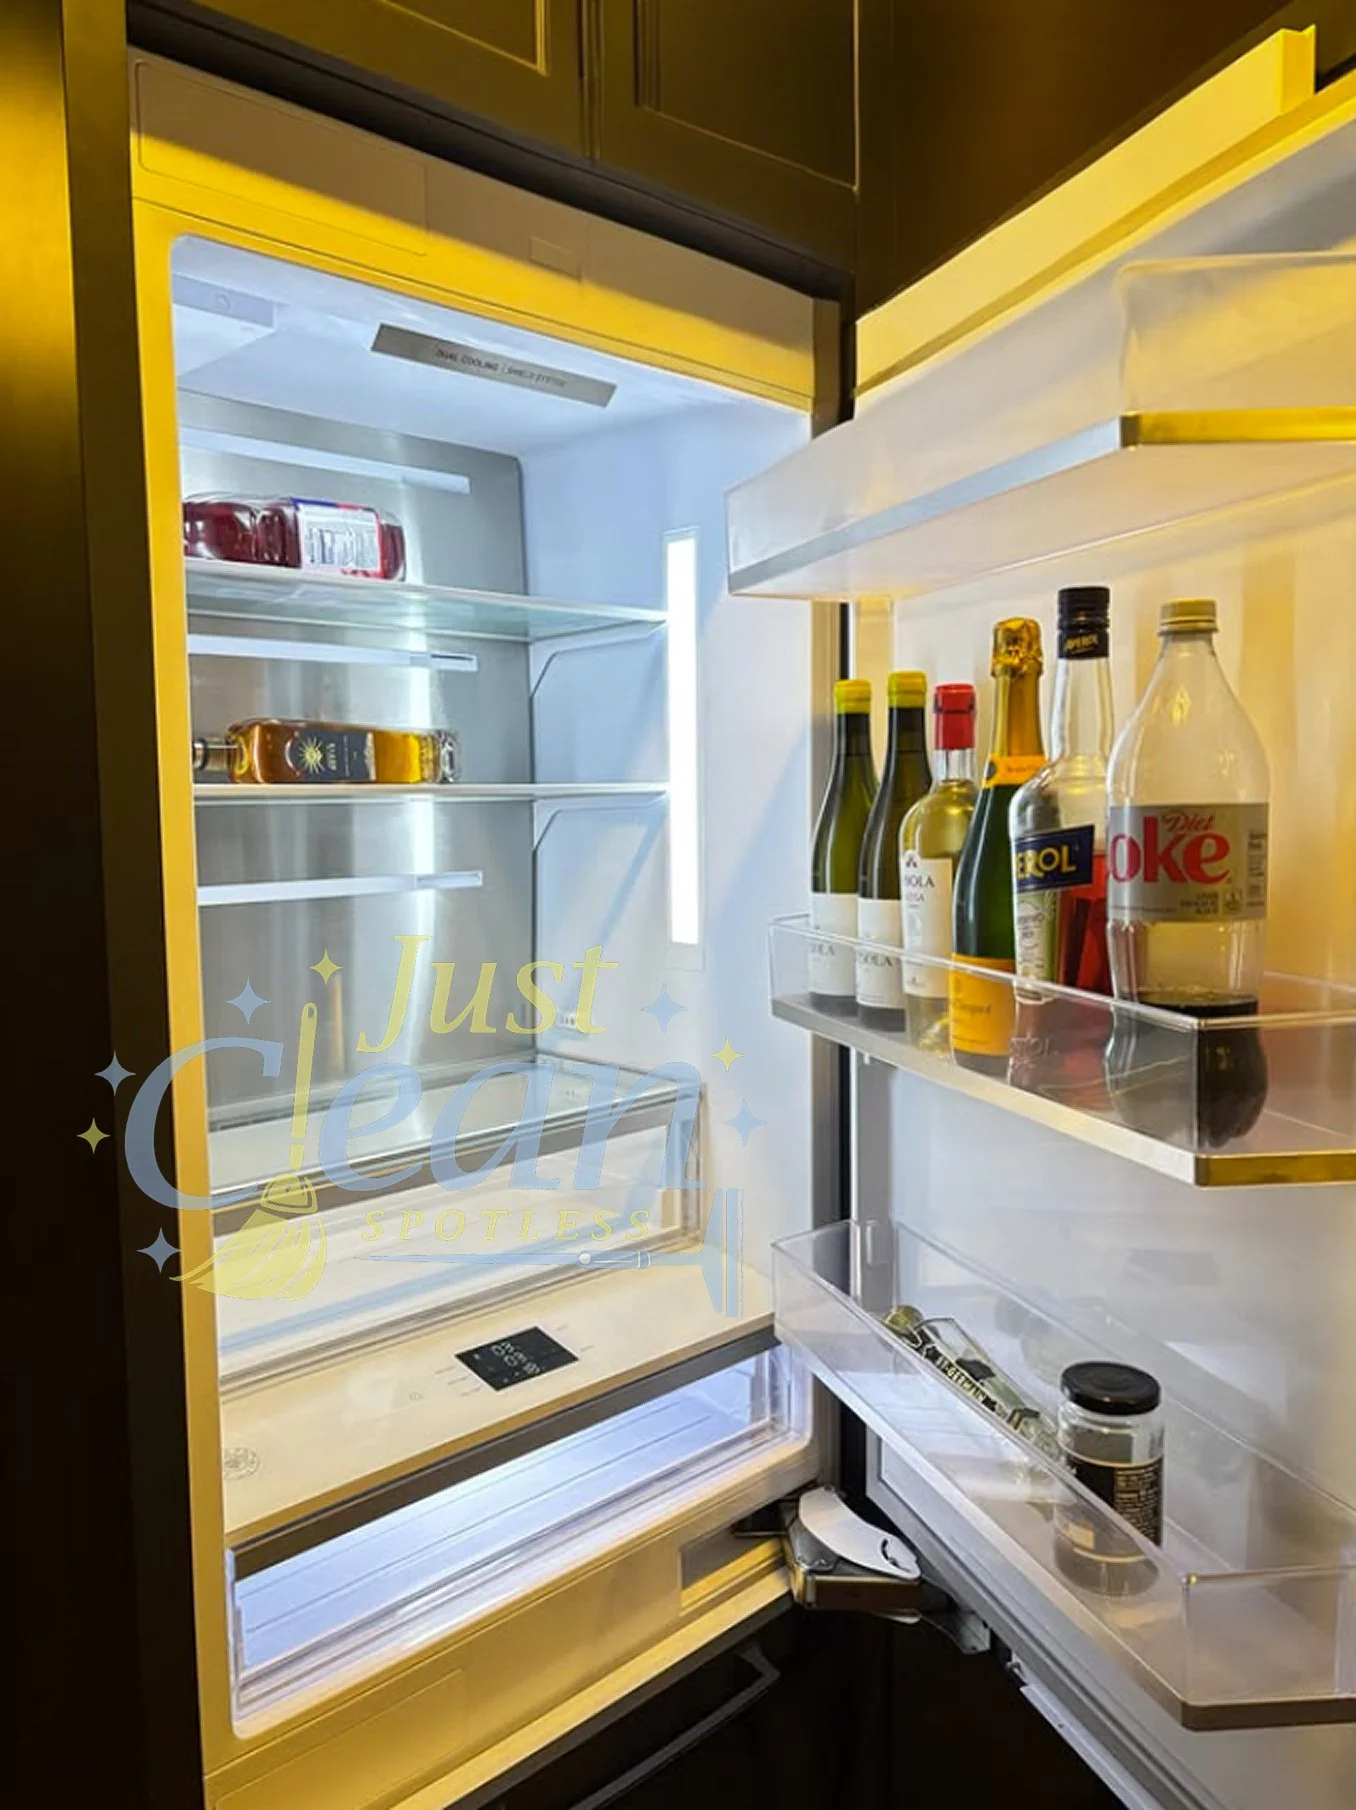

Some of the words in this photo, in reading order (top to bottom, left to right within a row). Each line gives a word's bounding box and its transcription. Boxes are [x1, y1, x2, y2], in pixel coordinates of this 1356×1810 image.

[1162, 810, 1216, 832] Diet
[1016, 845, 1076, 880] EROL
[1109, 816, 1230, 884] oke
